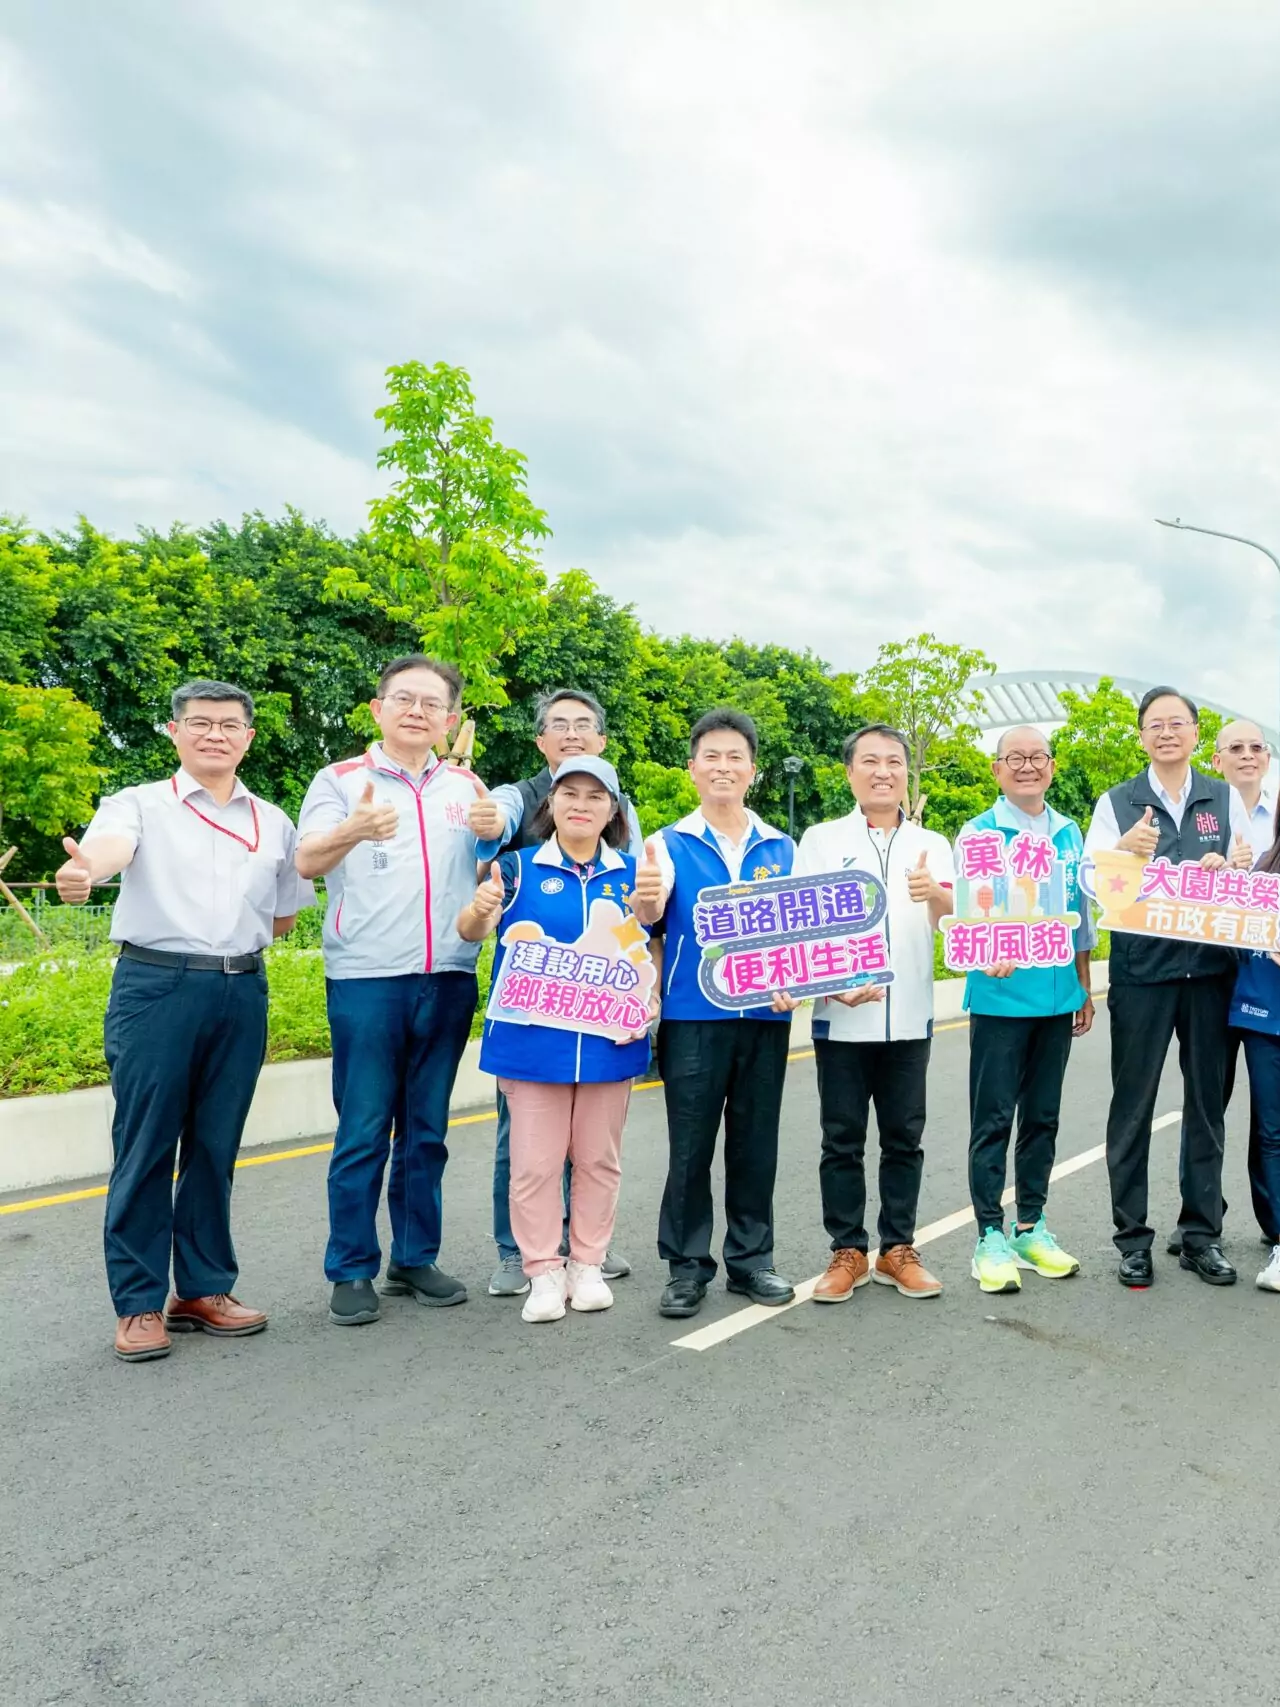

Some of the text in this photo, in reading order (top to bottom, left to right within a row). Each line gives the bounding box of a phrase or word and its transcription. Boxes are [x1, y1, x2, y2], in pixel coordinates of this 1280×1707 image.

[961, 835, 1056, 879] 菓林
[1141, 862, 1279, 911] 大園共榮
[697, 882, 866, 942] 道路開通
[1146, 902, 1273, 944] 市政有感
[511, 941, 639, 990] 建設用心
[721, 933, 886, 996] 便利生活
[950, 922, 1069, 965] 新風貌
[502, 974, 647, 1030] 鄉親放心
